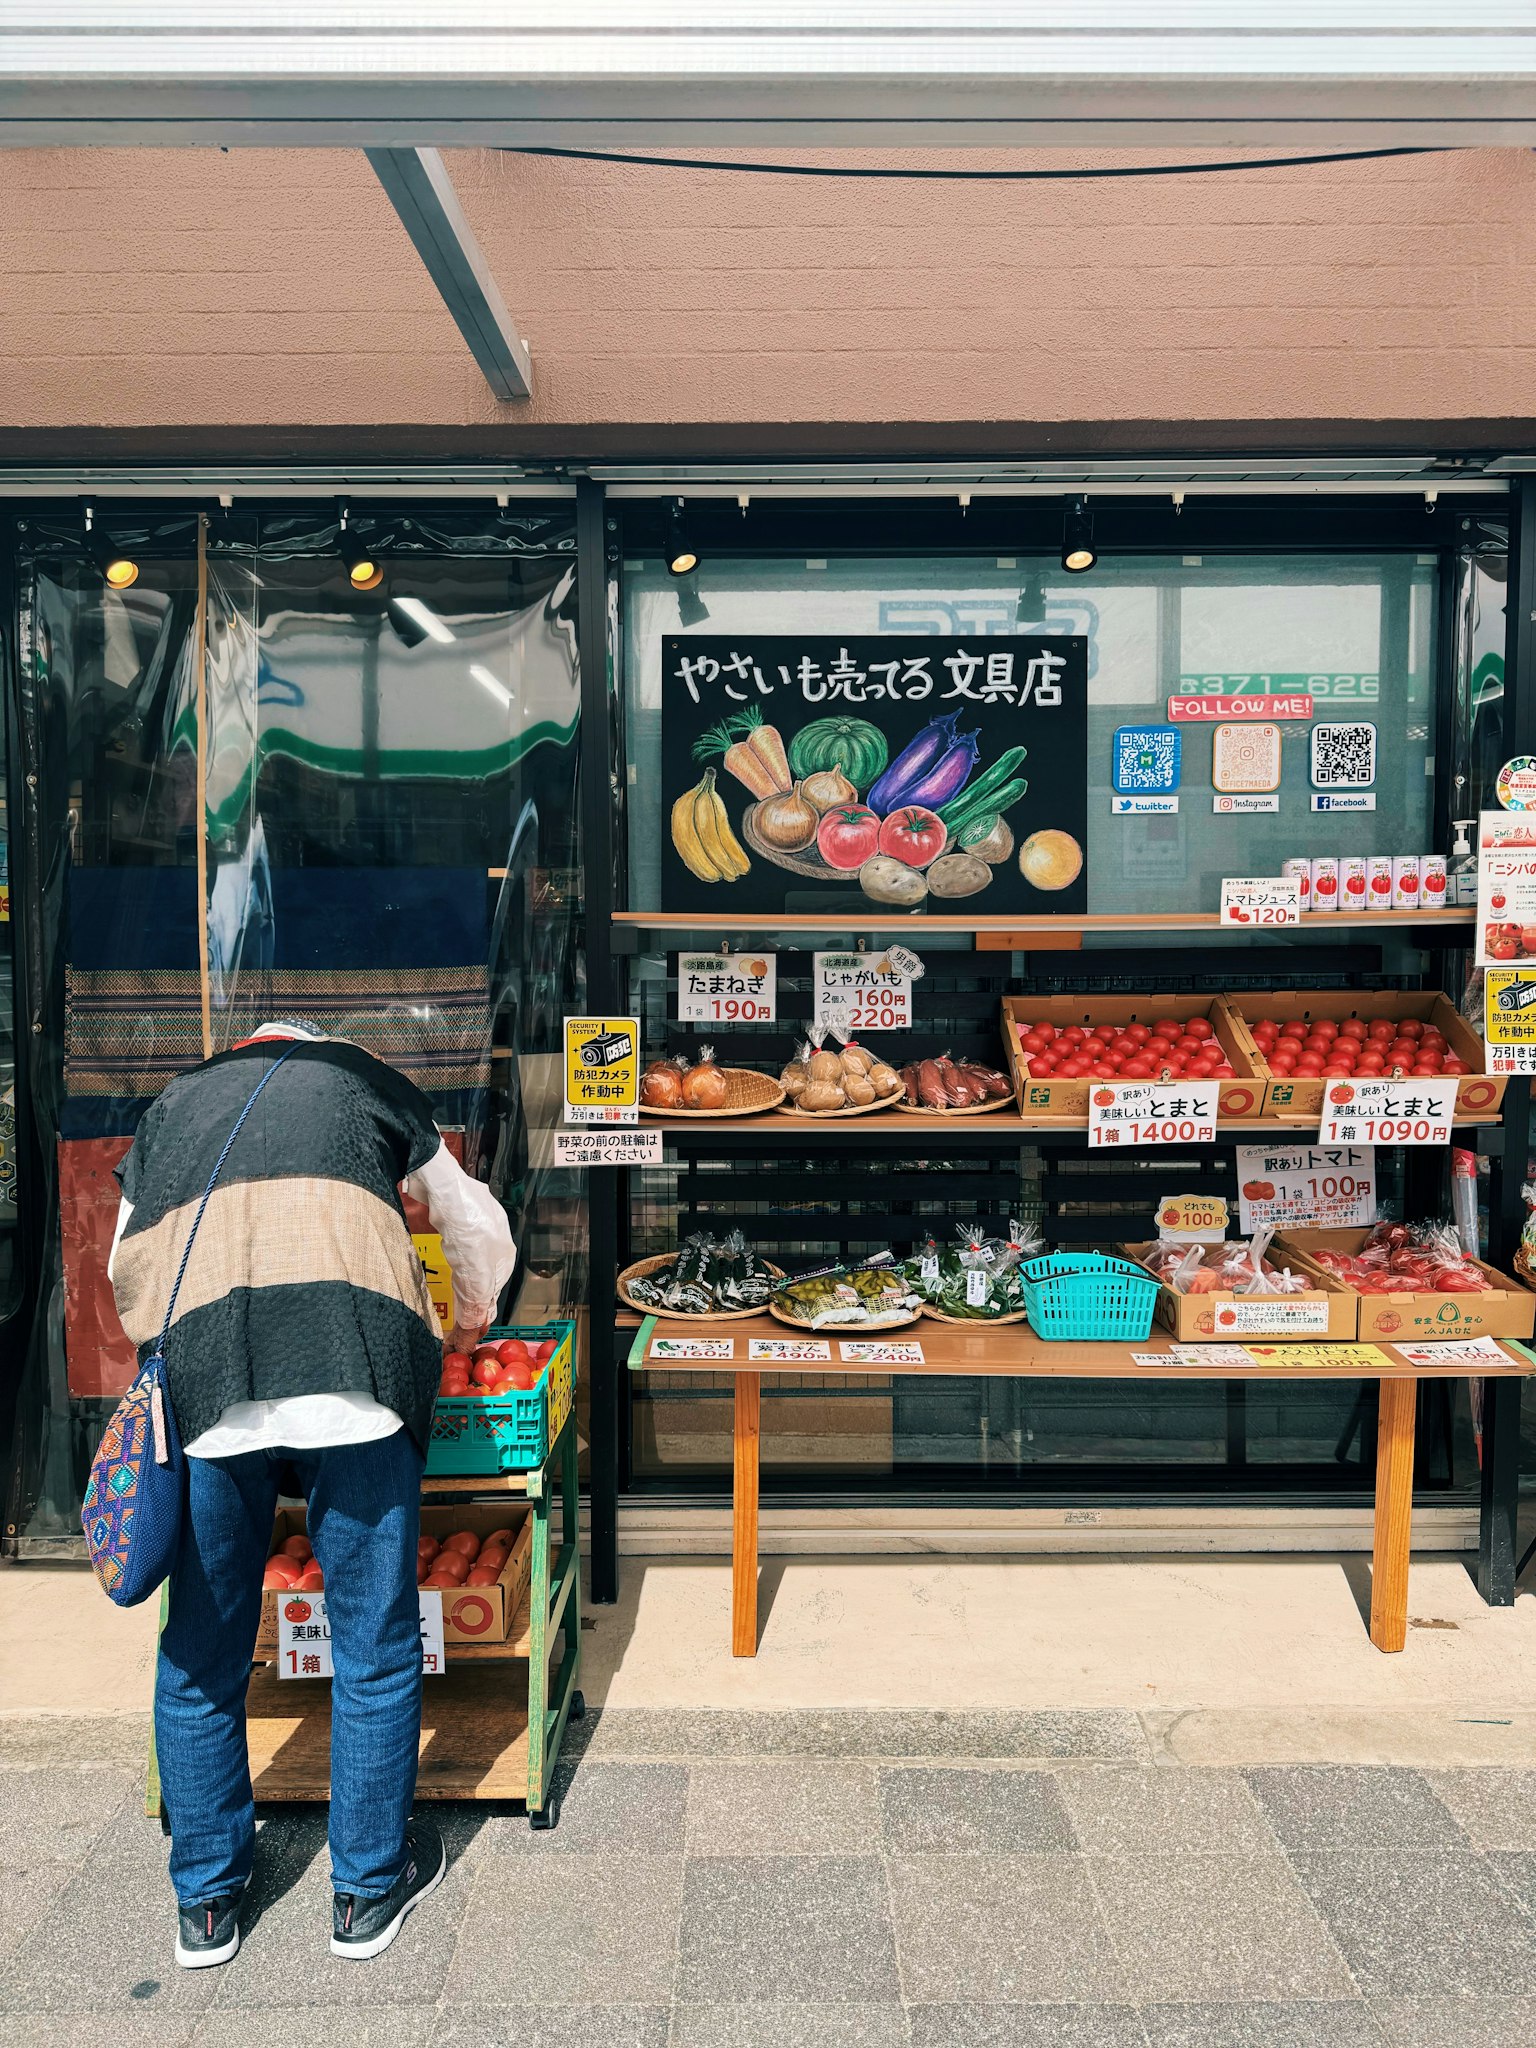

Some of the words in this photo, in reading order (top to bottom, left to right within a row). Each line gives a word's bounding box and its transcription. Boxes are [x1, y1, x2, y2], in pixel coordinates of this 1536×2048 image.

[1171, 700, 1264, 715] FOLLOW
[1273, 699, 1309, 713] ME!
[1135, 802, 1174, 811] twitter
[1233, 799, 1273, 810] Instagram
[1331, 799, 1367, 807] facebook
[1226, 894, 1297, 905] トマトジュース
[1252, 908, 1296, 923] 120円
[688, 974, 765, 994] たまねぎ
[824, 970, 902, 986] じゃがいも
[855, 989, 906, 1006] 160円
[711, 999, 771, 1020] 190円
[849, 1008, 907, 1027] 220円
[1499, 1026, 1535, 1037] 作動中
[574, 1069, 631, 1080] 防犯カメラ
[581, 1085, 625, 1098] 作動中
[1122, 1087, 1151, 1100] 訳あり
[1361, 1084, 1390, 1096] 訳あり
[570, 1111, 638, 1121] 万引きは犯罪です
[1093, 1126, 1120, 1144] 1箱
[1129, 1121, 1213, 1143] 1400円
[1328, 1122, 1356, 1140] 1箱
[1365, 1120, 1447, 1141] 1090円
[557, 1134, 658, 1148] 野菜の前の駐輪は
[565, 1149, 653, 1162] ご遠慮ください
[1264, 1147, 1362, 1171] 訳ありトマト
[1307, 1176, 1371, 1198] 100円
[1184, 1202, 1215, 1210] どれでも
[1183, 1213, 1223, 1226] 100円
[1414, 1317, 1432, 1325] 安全
[872, 1353, 921, 1362] 240円
[1453, 1352, 1502, 1360] 100円
[286, 1650, 321, 1674] 1箱
